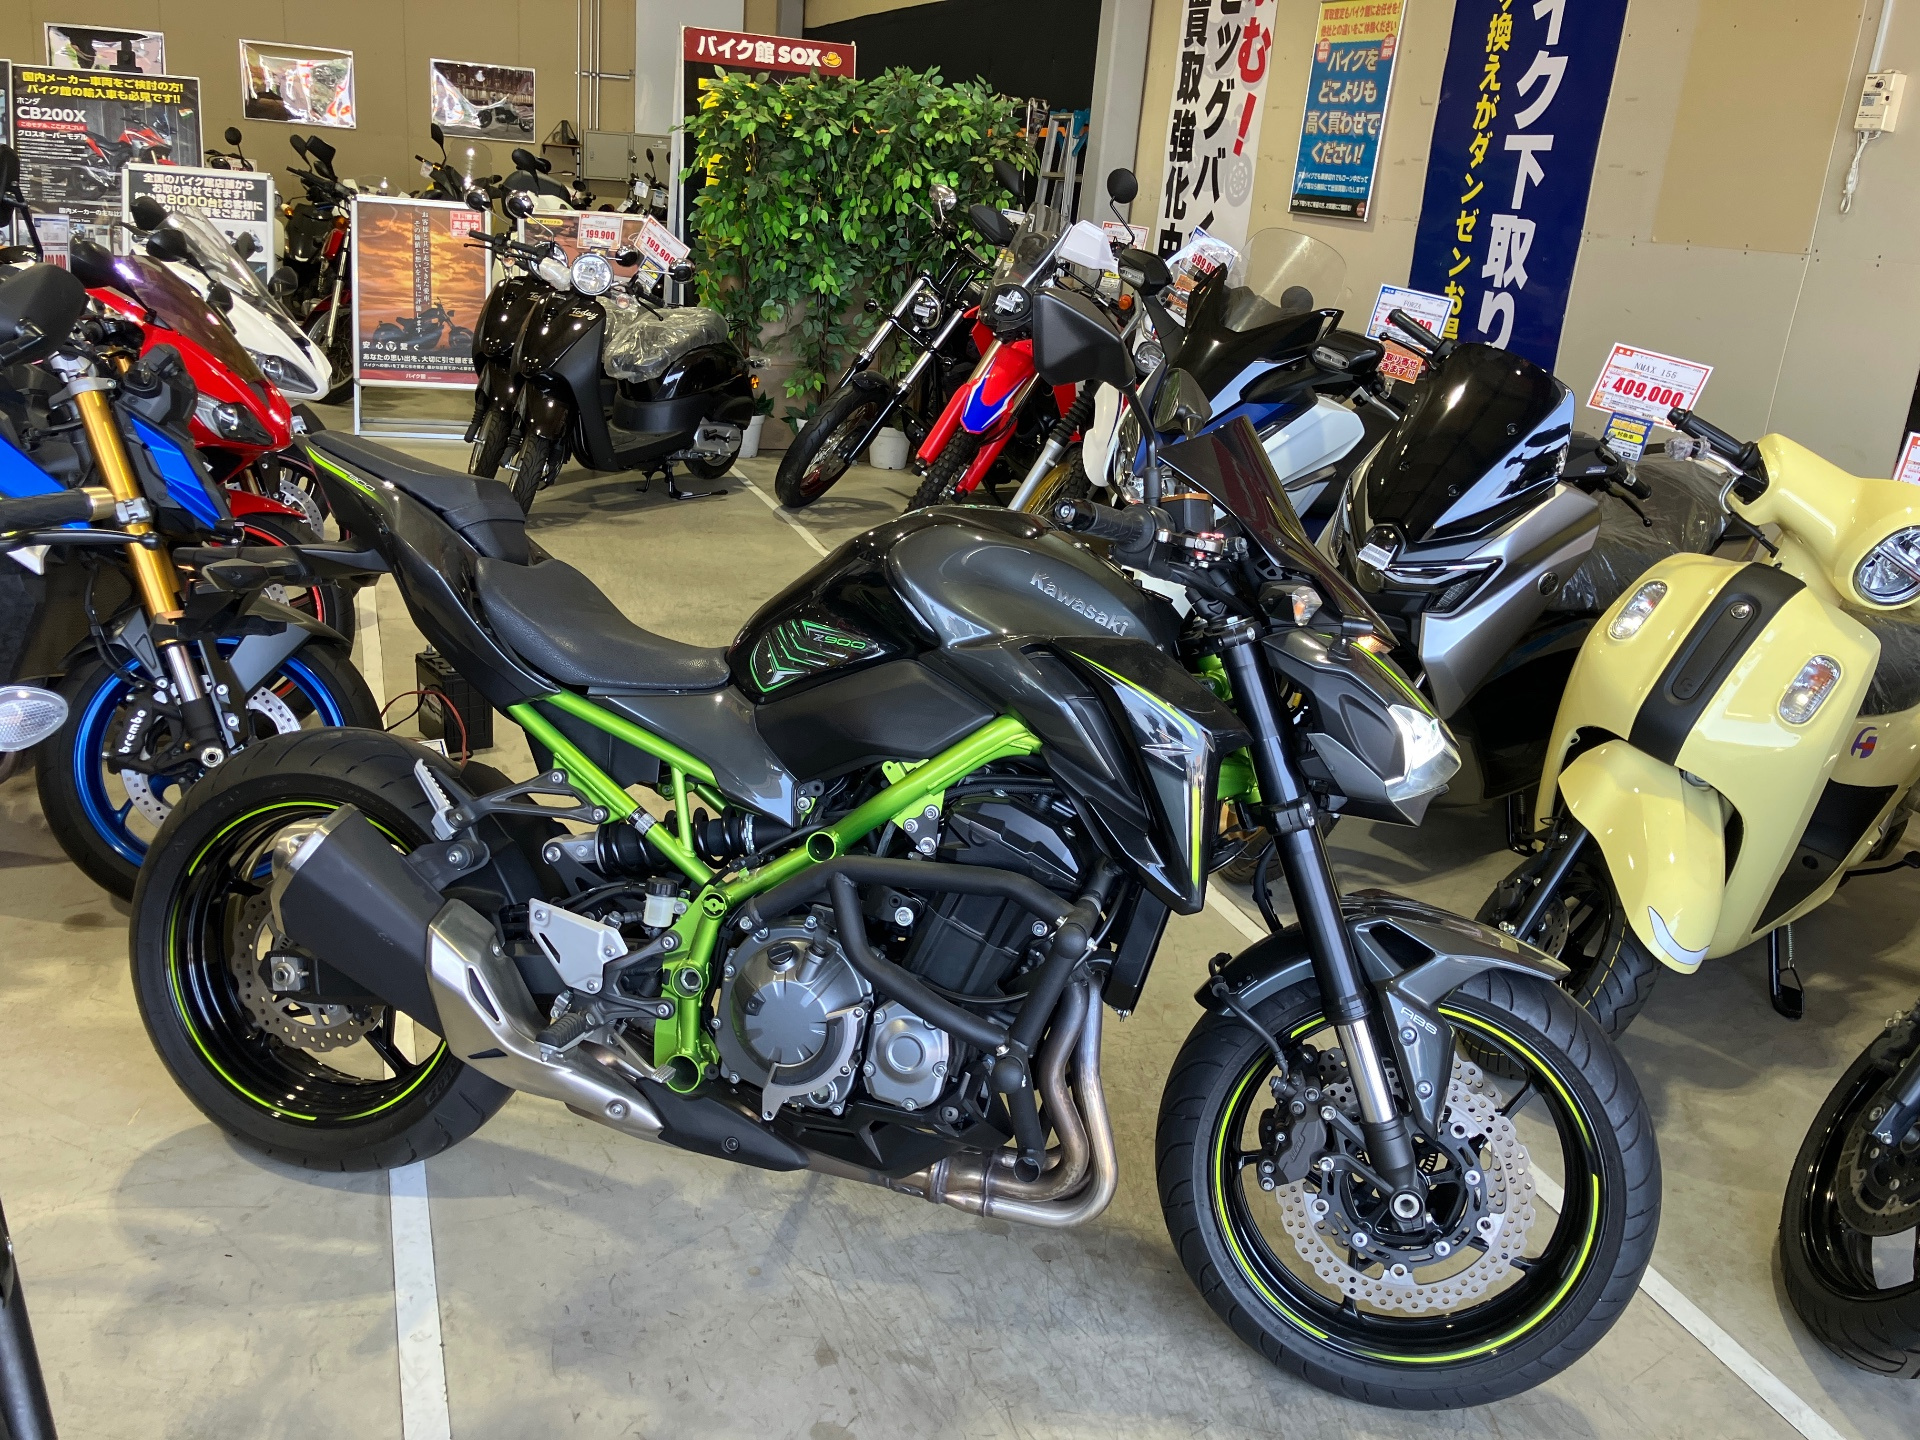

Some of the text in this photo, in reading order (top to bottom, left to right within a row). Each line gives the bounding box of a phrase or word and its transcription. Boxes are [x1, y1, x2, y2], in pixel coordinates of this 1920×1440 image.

[697, 36, 822, 67] バイク館 SOX
[1327, 48, 1379, 72] バイクを
[22, 72, 184, 93] 国内メーカー車両をご検討の方!
[1233, 0, 1274, 157] む!
[16, 97, 41, 106] ホンダ
[27, 84, 181, 104] バイク館の輸入車も必見です!!
[1318, 80, 1377, 103] どこよりも
[16, 106, 87, 123] CB200X
[1189, 0, 1241, 238] ッグバ
[1443, 0, 1514, 340] 換えがダンゼンお
[572, 307, 599, 321] Today
[1634, 362, 1656, 375] NMAX
[1660, 370, 1678, 379] 155
[1612, 377, 1685, 408] 409,000
[1029, 568, 1130, 637] Kawasaki
[813, 632, 866, 650] Z900
[118, 709, 148, 754] brembo
[1400, 1006, 1438, 1035] ABS
